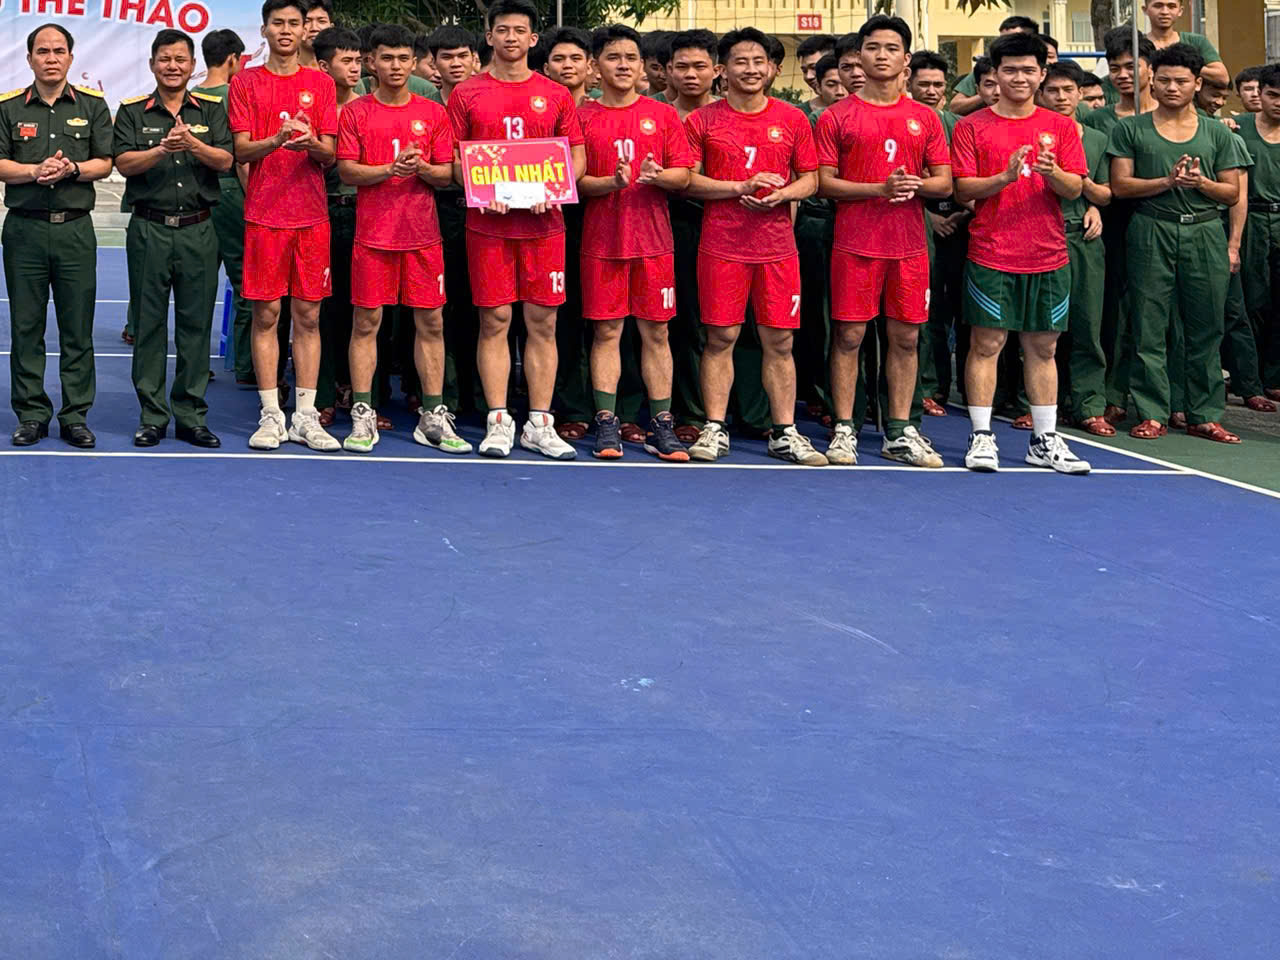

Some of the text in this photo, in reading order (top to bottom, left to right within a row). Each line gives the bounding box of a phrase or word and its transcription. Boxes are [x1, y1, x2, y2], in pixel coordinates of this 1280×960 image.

[503, 116, 524, 140] 13
[613, 138, 636, 163] 10
[744, 146, 758, 169] 7
[884, 138, 897, 163] 9
[470, 156, 566, 185] GIẢI NHẤT
[549, 270, 566, 295] 13
[660, 286, 675, 310] 10
[790, 294, 801, 317] 7
